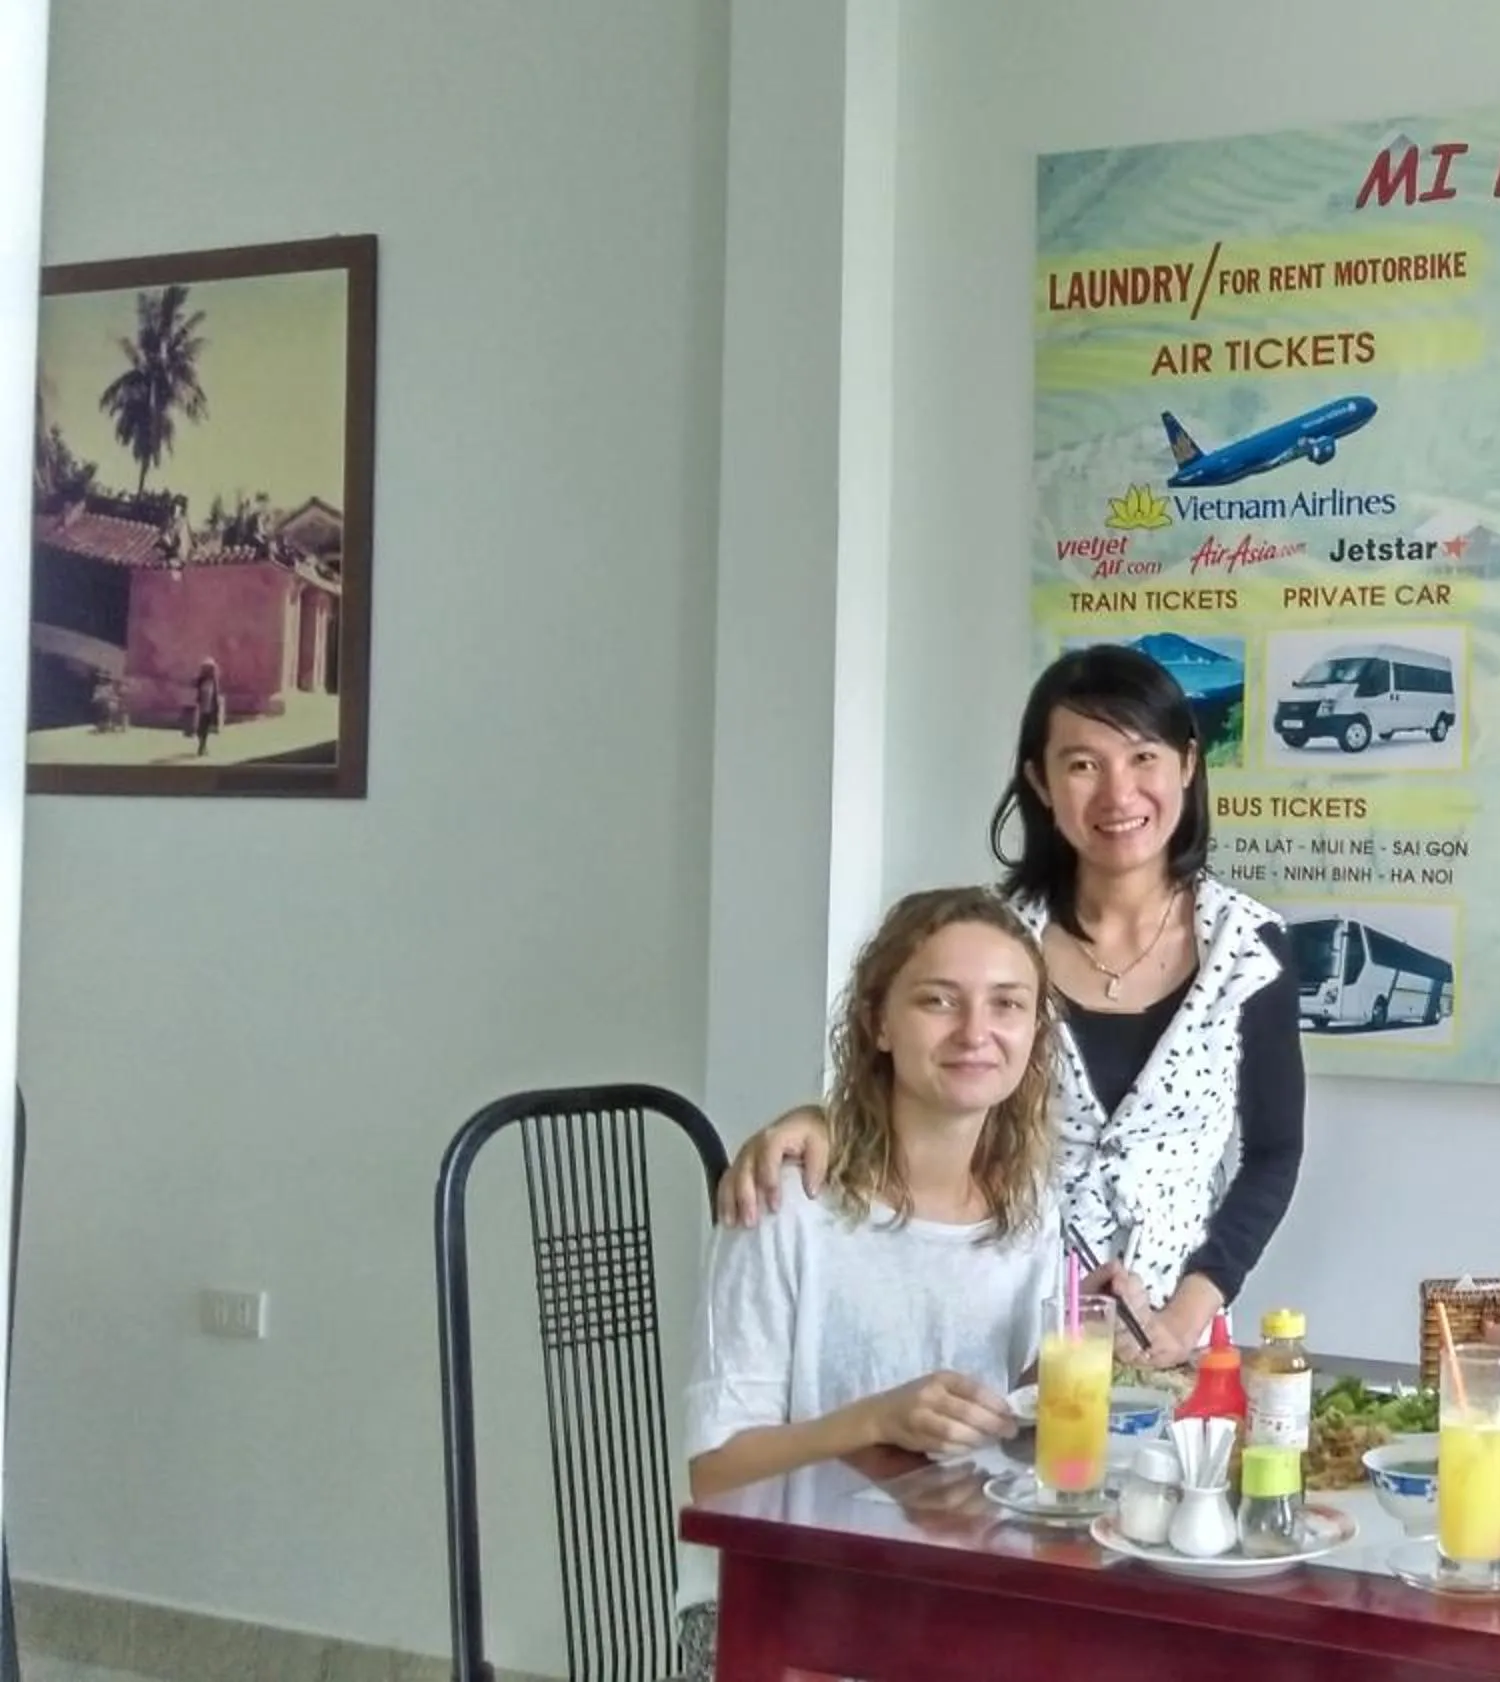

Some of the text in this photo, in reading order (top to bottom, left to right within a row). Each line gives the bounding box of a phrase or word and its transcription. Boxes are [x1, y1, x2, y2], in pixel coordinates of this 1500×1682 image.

[1355, 142, 1468, 209] MI
[1269, 263, 1325, 292] RENT
[1334, 251, 1467, 284] MOTORBIKE
[1151, 332, 1375, 376] AIR TICKETS
[1174, 487, 1397, 521] Vietnam Airlines
[1329, 536, 1438, 562] Jetstar
[1070, 588, 1237, 614] TRAIN TICKETS
[1283, 584, 1451, 609] PRIVATE CAR
[1217, 796, 1367, 818] BUS TICKETS
[1235, 838, 1260, 853] DA
[1265, 839, 1293, 855] LAT
[1311, 838, 1344, 855] MUI
[1350, 839, 1374, 855] NE
[1392, 839, 1420, 857] SAI
[1425, 839, 1469, 857] GON
[1231, 863, 1266, 881] HUE
[1284, 864, 1326, 882] NINH
[1332, 866, 1372, 883] BINH
[1391, 867, 1416, 885] HA
[1422, 867, 1454, 885] NOI
